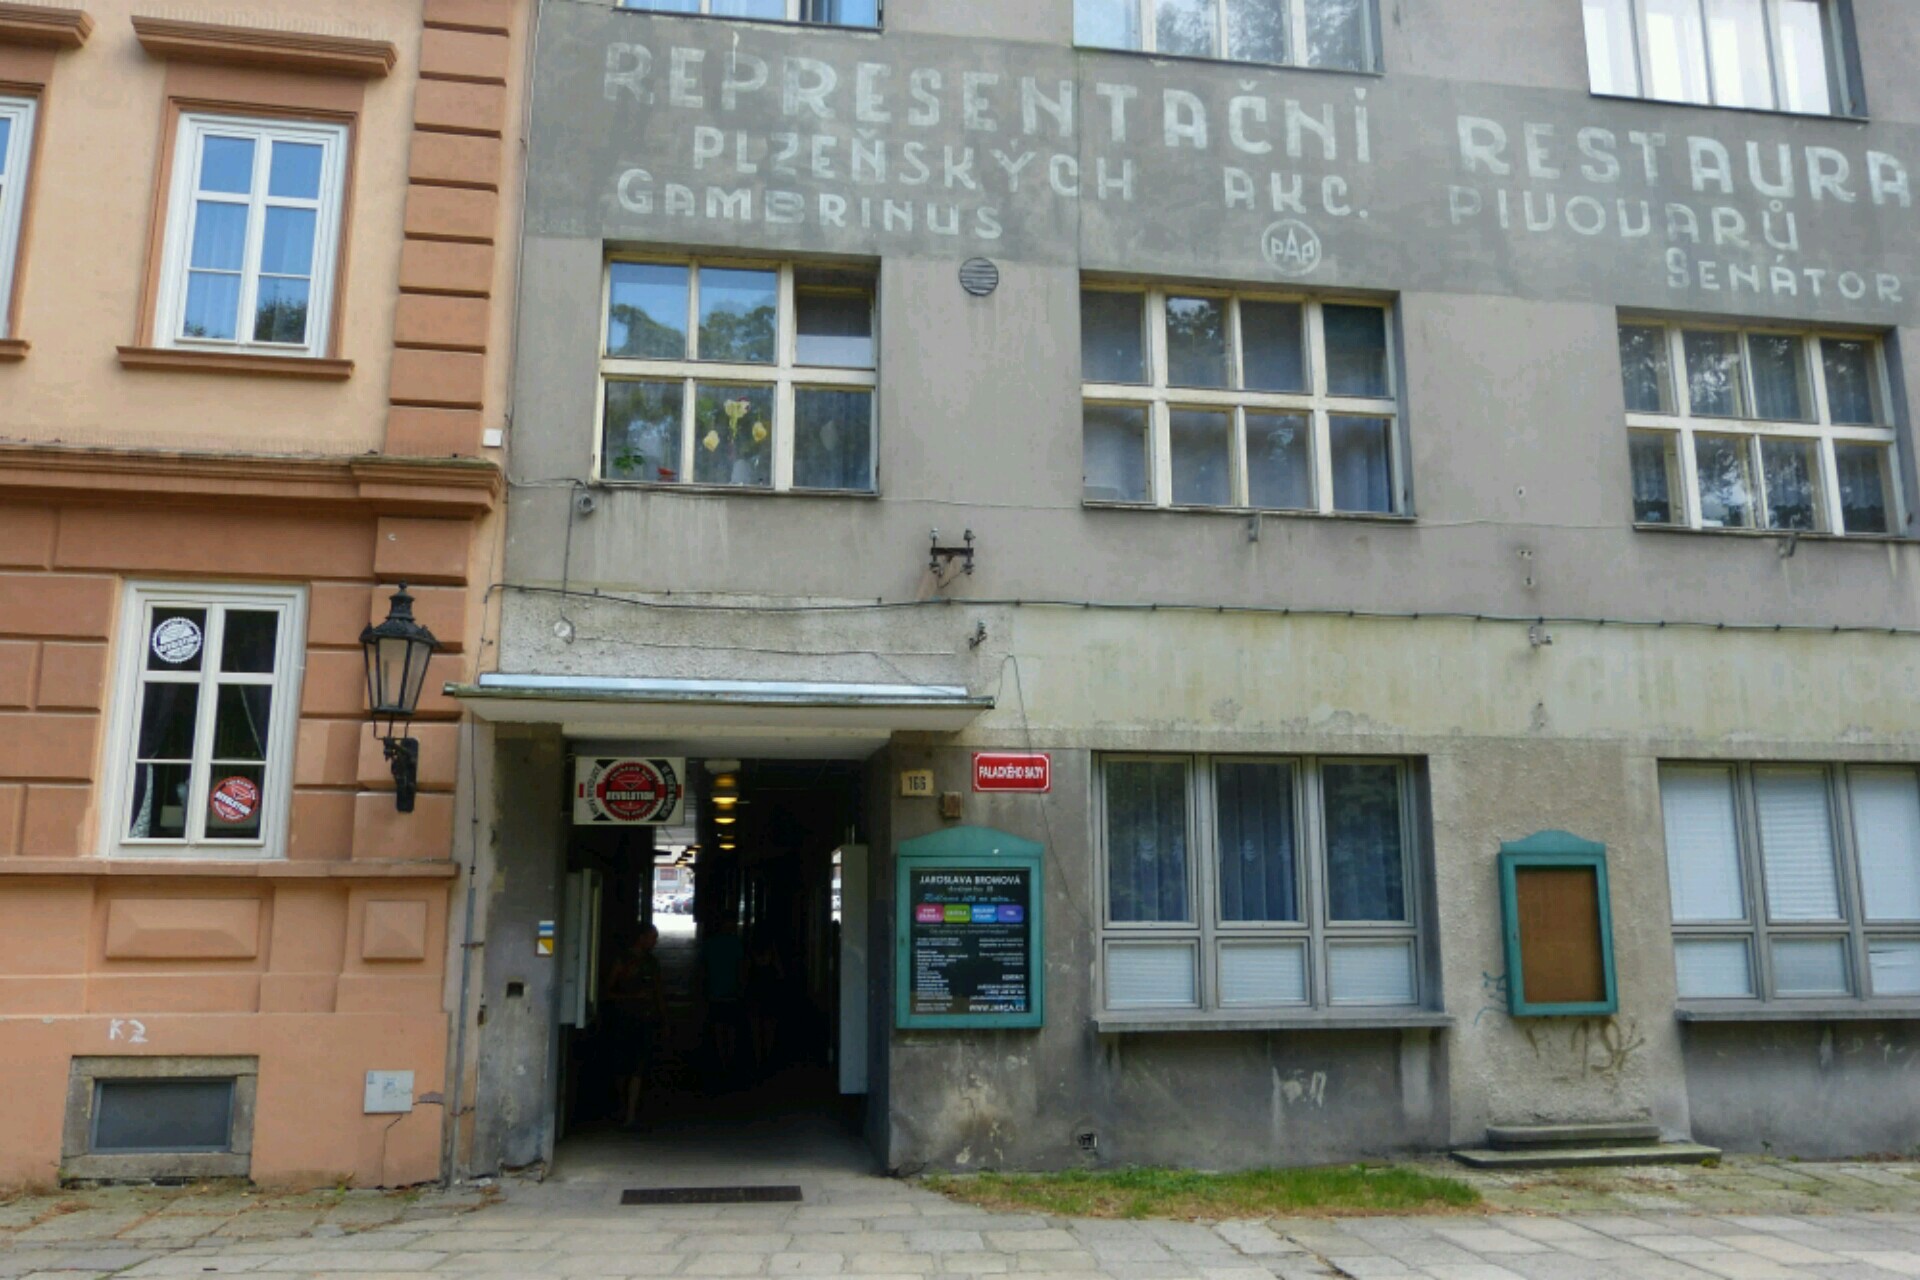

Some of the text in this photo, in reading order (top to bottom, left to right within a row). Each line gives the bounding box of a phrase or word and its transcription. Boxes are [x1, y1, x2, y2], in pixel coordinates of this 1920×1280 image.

[604, 42, 1370, 162] REPRESENTAČNÍ
[616, 168, 1003, 239] GAMBRINUS
[693, 126, 1136, 201] PLZEŇSKÝCH
[1223, 166, 1369, 219] AKC.
[1666, 246, 1904, 303] SENÁTOR
[978, 763, 1024, 780] PALACKÉHO
